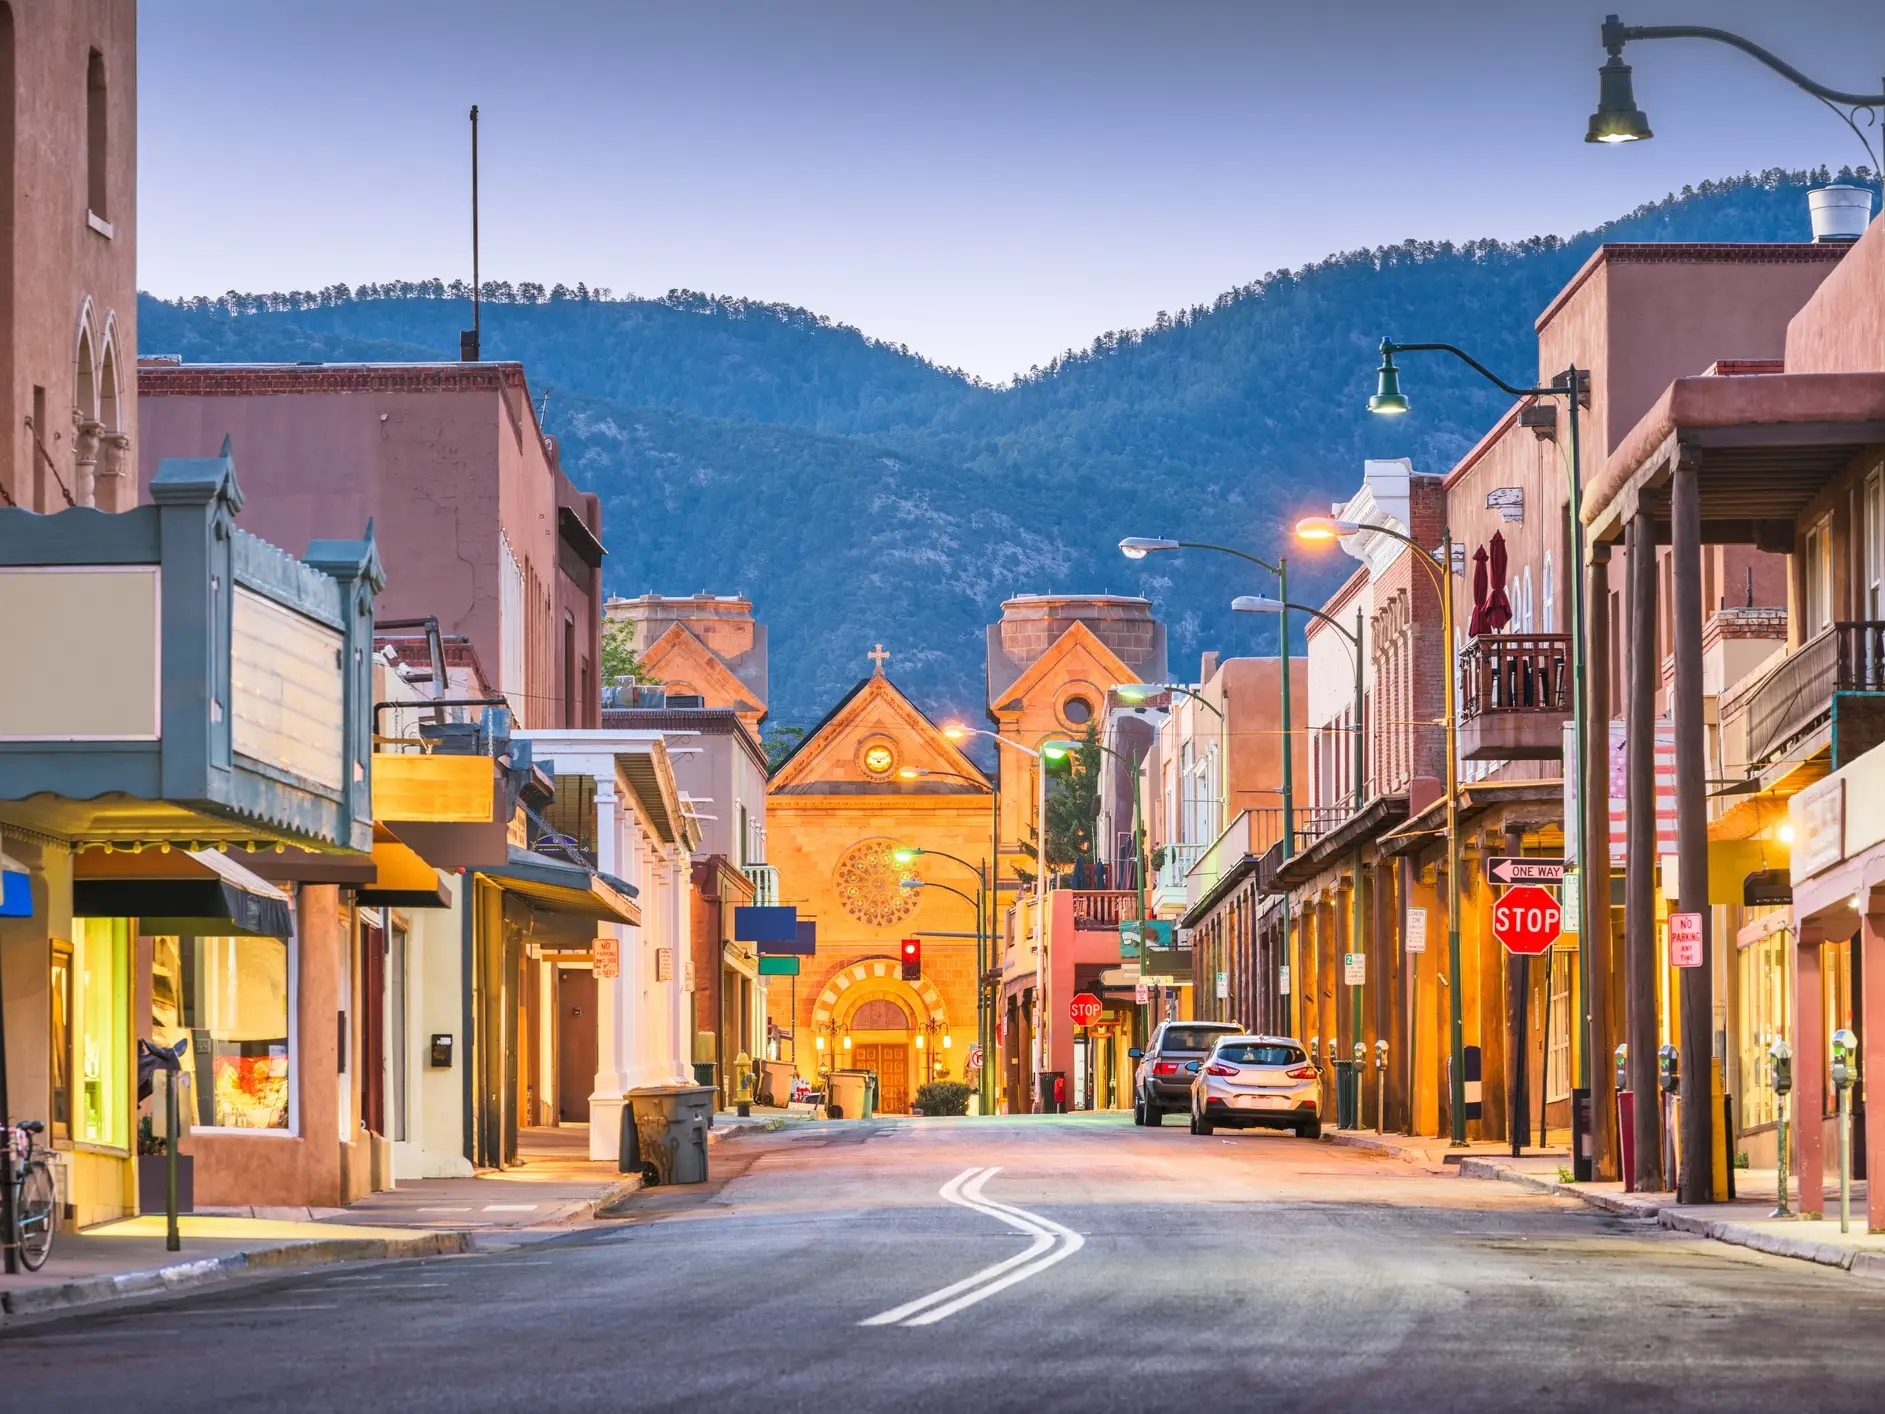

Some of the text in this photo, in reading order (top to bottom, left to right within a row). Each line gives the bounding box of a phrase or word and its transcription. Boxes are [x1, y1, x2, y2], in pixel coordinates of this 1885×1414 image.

[1512, 866, 1561, 877] ONE WAY
[1495, 907, 1560, 933] STOP
[1680, 920, 1693, 929] NO
[1671, 932, 1700, 942] PARKING
[600, 942, 611, 950] NO
[1680, 954, 1693, 962] TIME
[1071, 1003, 1101, 1017] STOP
